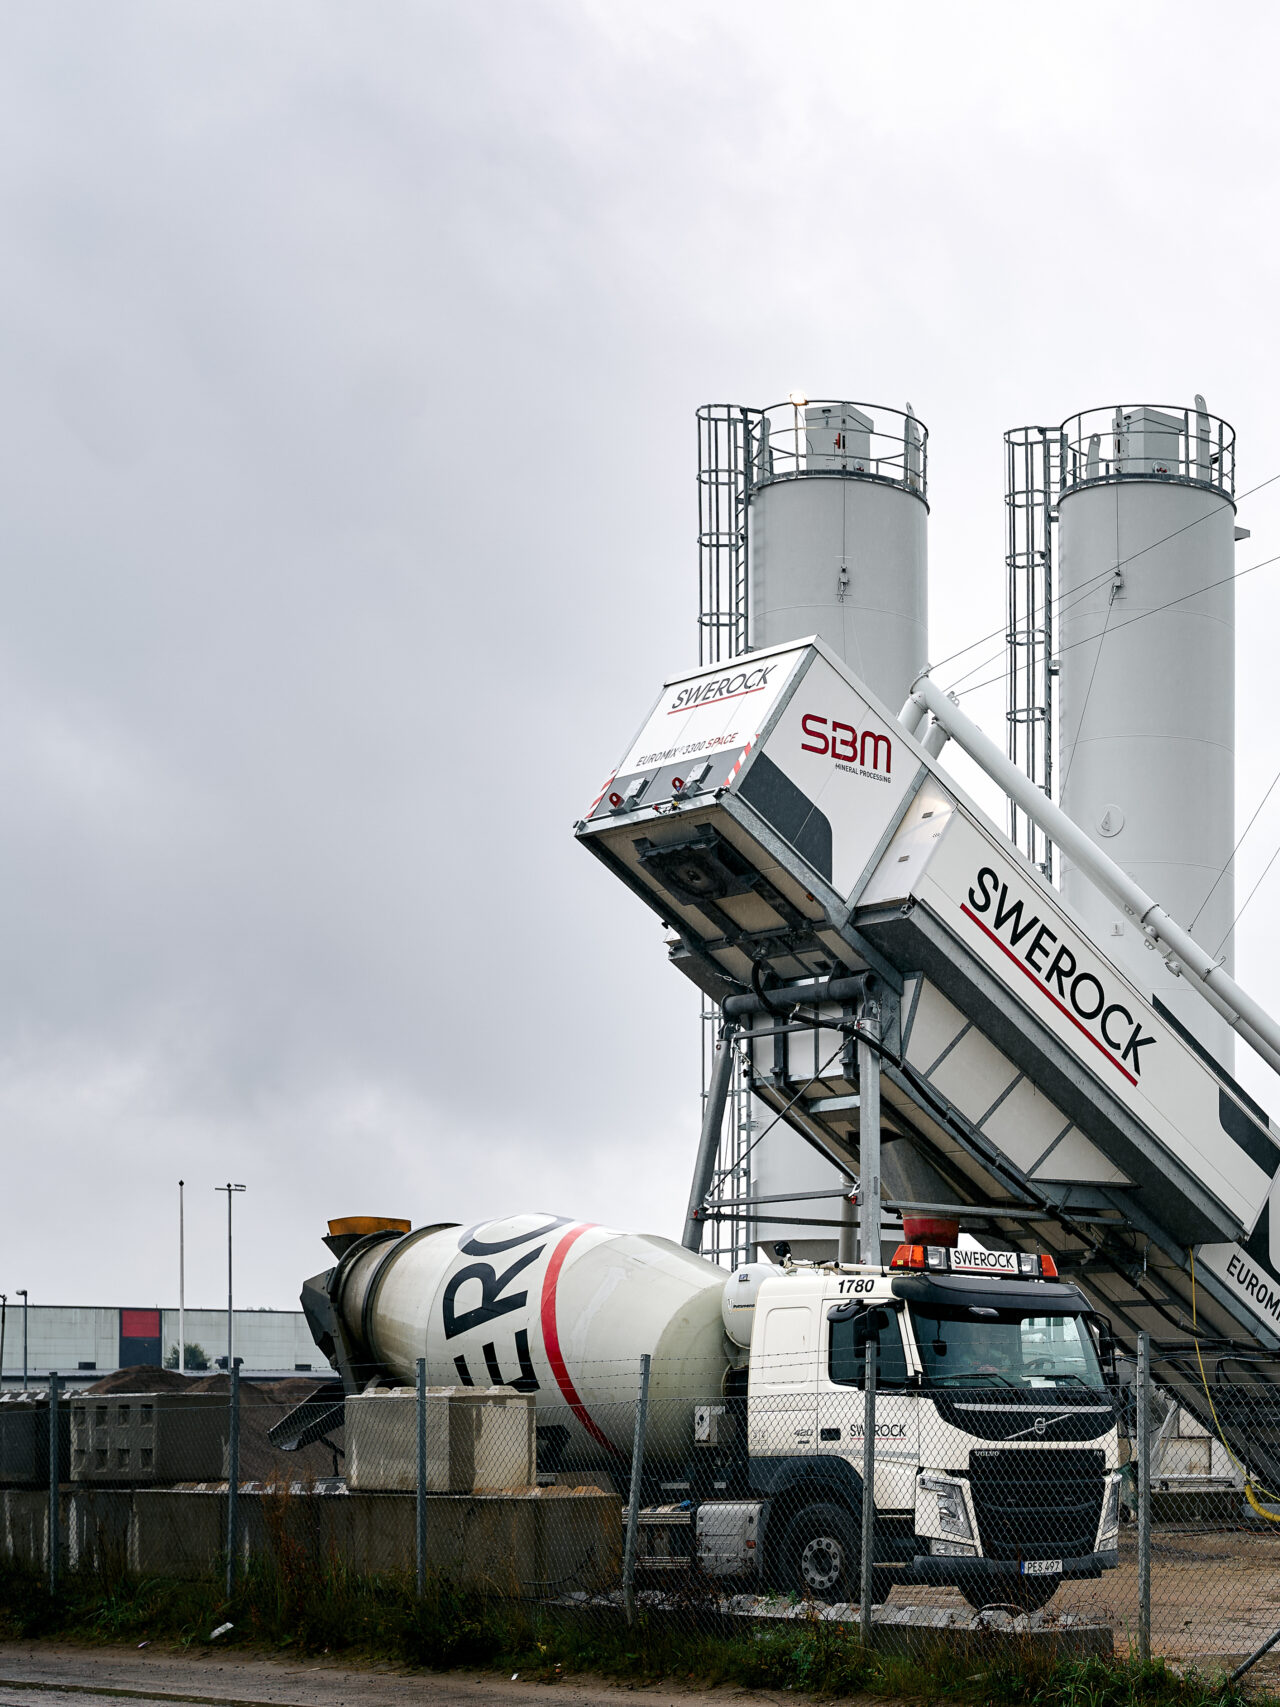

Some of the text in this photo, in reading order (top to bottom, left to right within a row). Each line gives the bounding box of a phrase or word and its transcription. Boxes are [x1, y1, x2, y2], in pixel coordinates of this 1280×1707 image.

[672, 664, 777, 709] SWEROCK
[682, 740, 706, 755] 3300
[705, 732, 739, 749] SPACE
[801, 713, 892, 774] SBM
[835, 762, 892, 784] MINERAL PROCESSING
[968, 866, 1158, 1077] SWEROCK
[953, 1250, 1015, 1269] SWEROCK
[838, 1279, 875, 1294] 1780
[794, 1429, 814, 1437] 420
[850, 1424, 907, 1437] SWROCK
